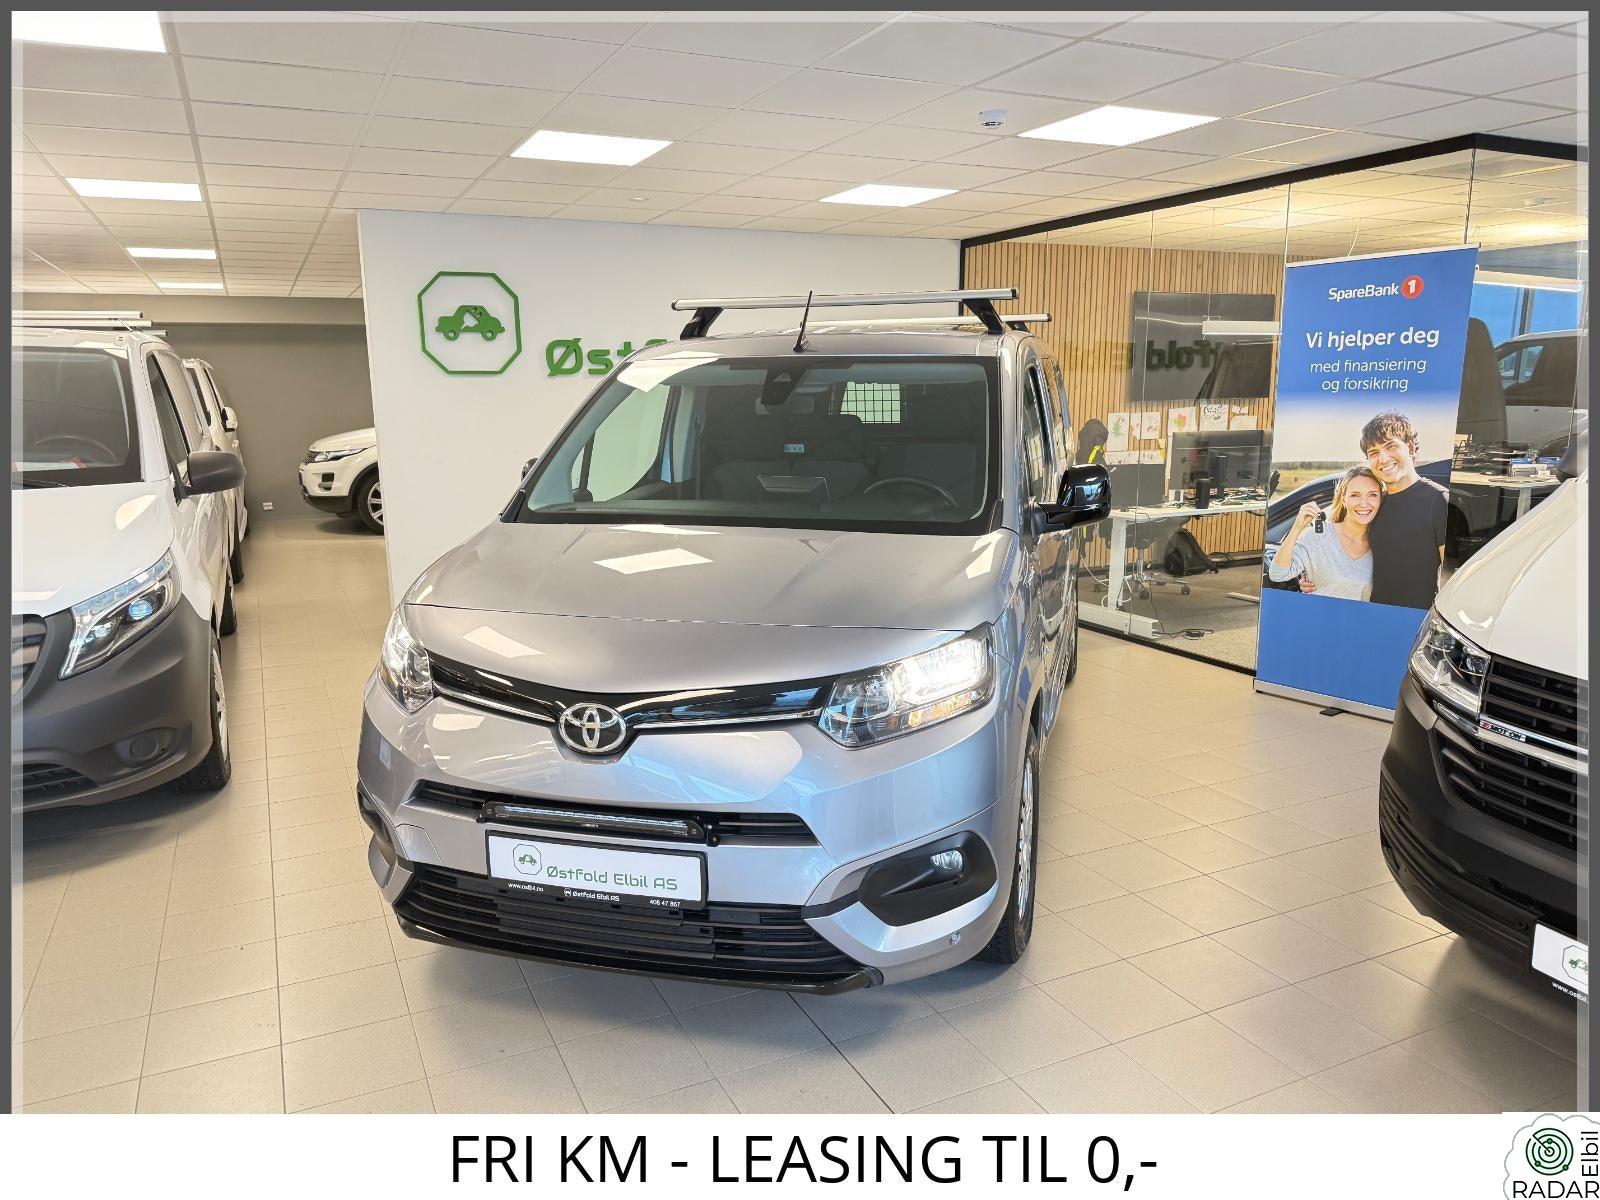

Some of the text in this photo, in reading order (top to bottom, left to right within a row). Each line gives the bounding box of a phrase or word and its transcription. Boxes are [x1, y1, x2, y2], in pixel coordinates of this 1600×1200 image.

[1328, 282, 1399, 302] SpareBank
[1306, 326, 1440, 351] Vi hjelper deg
[1310, 358, 1427, 374] med finansiering
[1321, 376, 1409, 393] og forsikring
[546, 865, 678, 891] Østfold Elbil AS
